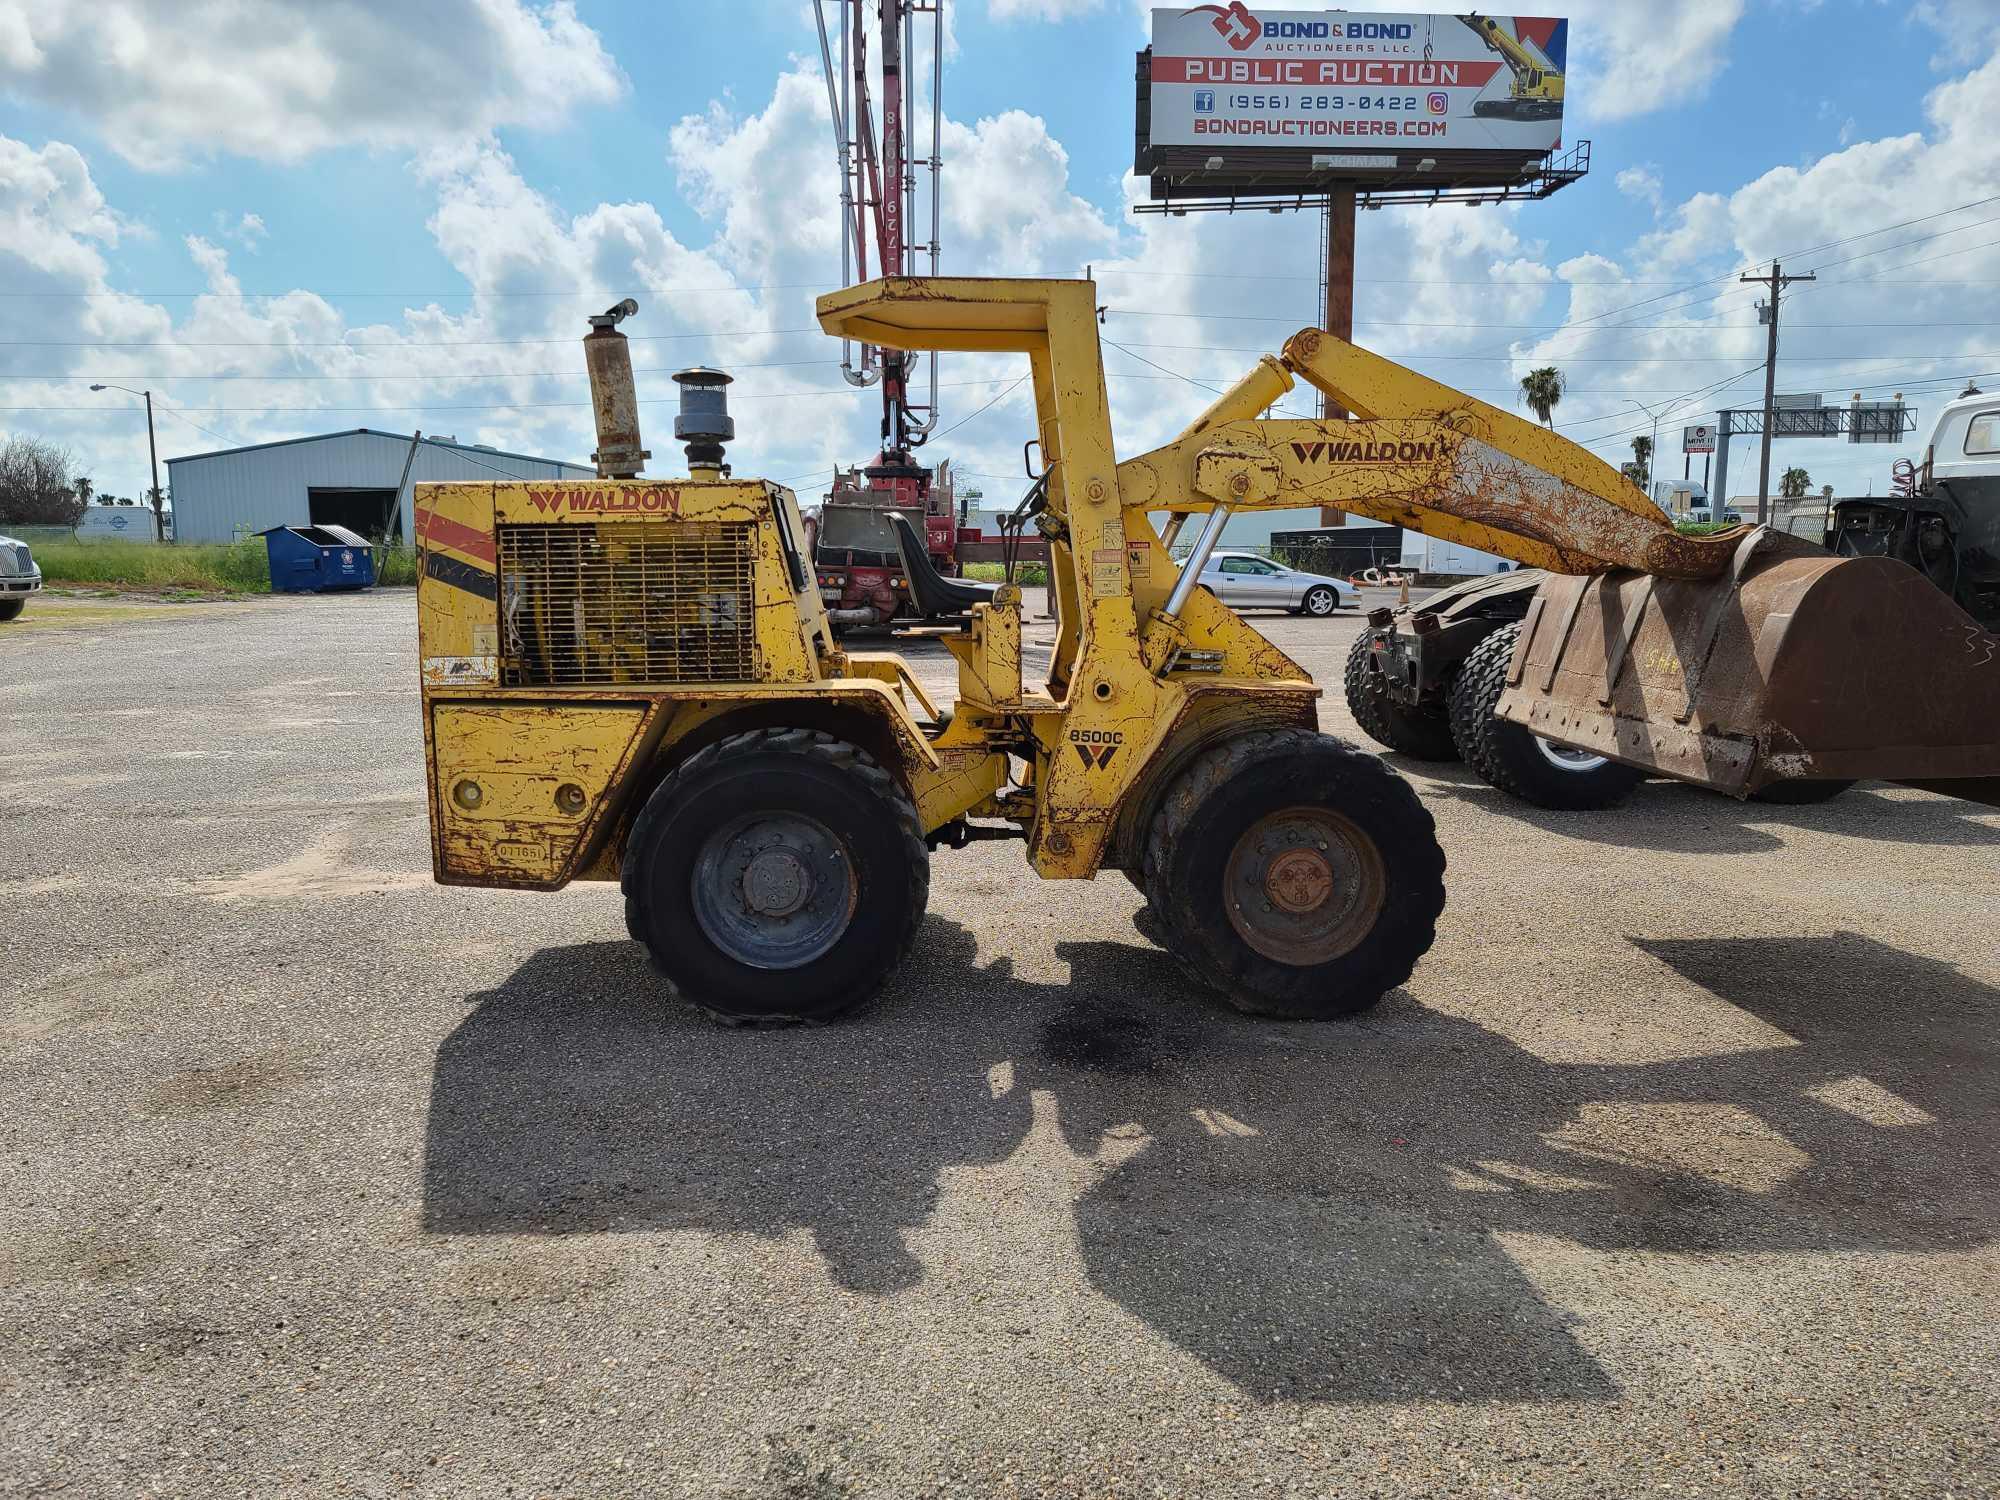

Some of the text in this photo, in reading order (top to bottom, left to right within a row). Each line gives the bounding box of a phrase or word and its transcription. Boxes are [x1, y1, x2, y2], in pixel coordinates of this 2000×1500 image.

[1263, 22, 1412, 39] BOND & BOND
[1265, 43, 1416, 53] AUCTIONEERS LLC.
[1186, 61, 1459, 84] PUBLIC AUCTION
[1229, 95, 1417, 110] (956) 283-0422
[1194, 119, 1447, 137] BONDAUCTIONEERS.COM
[1328, 442, 1436, 462] WALDON
[568, 489, 681, 511] WALDON
[1070, 729, 1123, 745] 8500C
